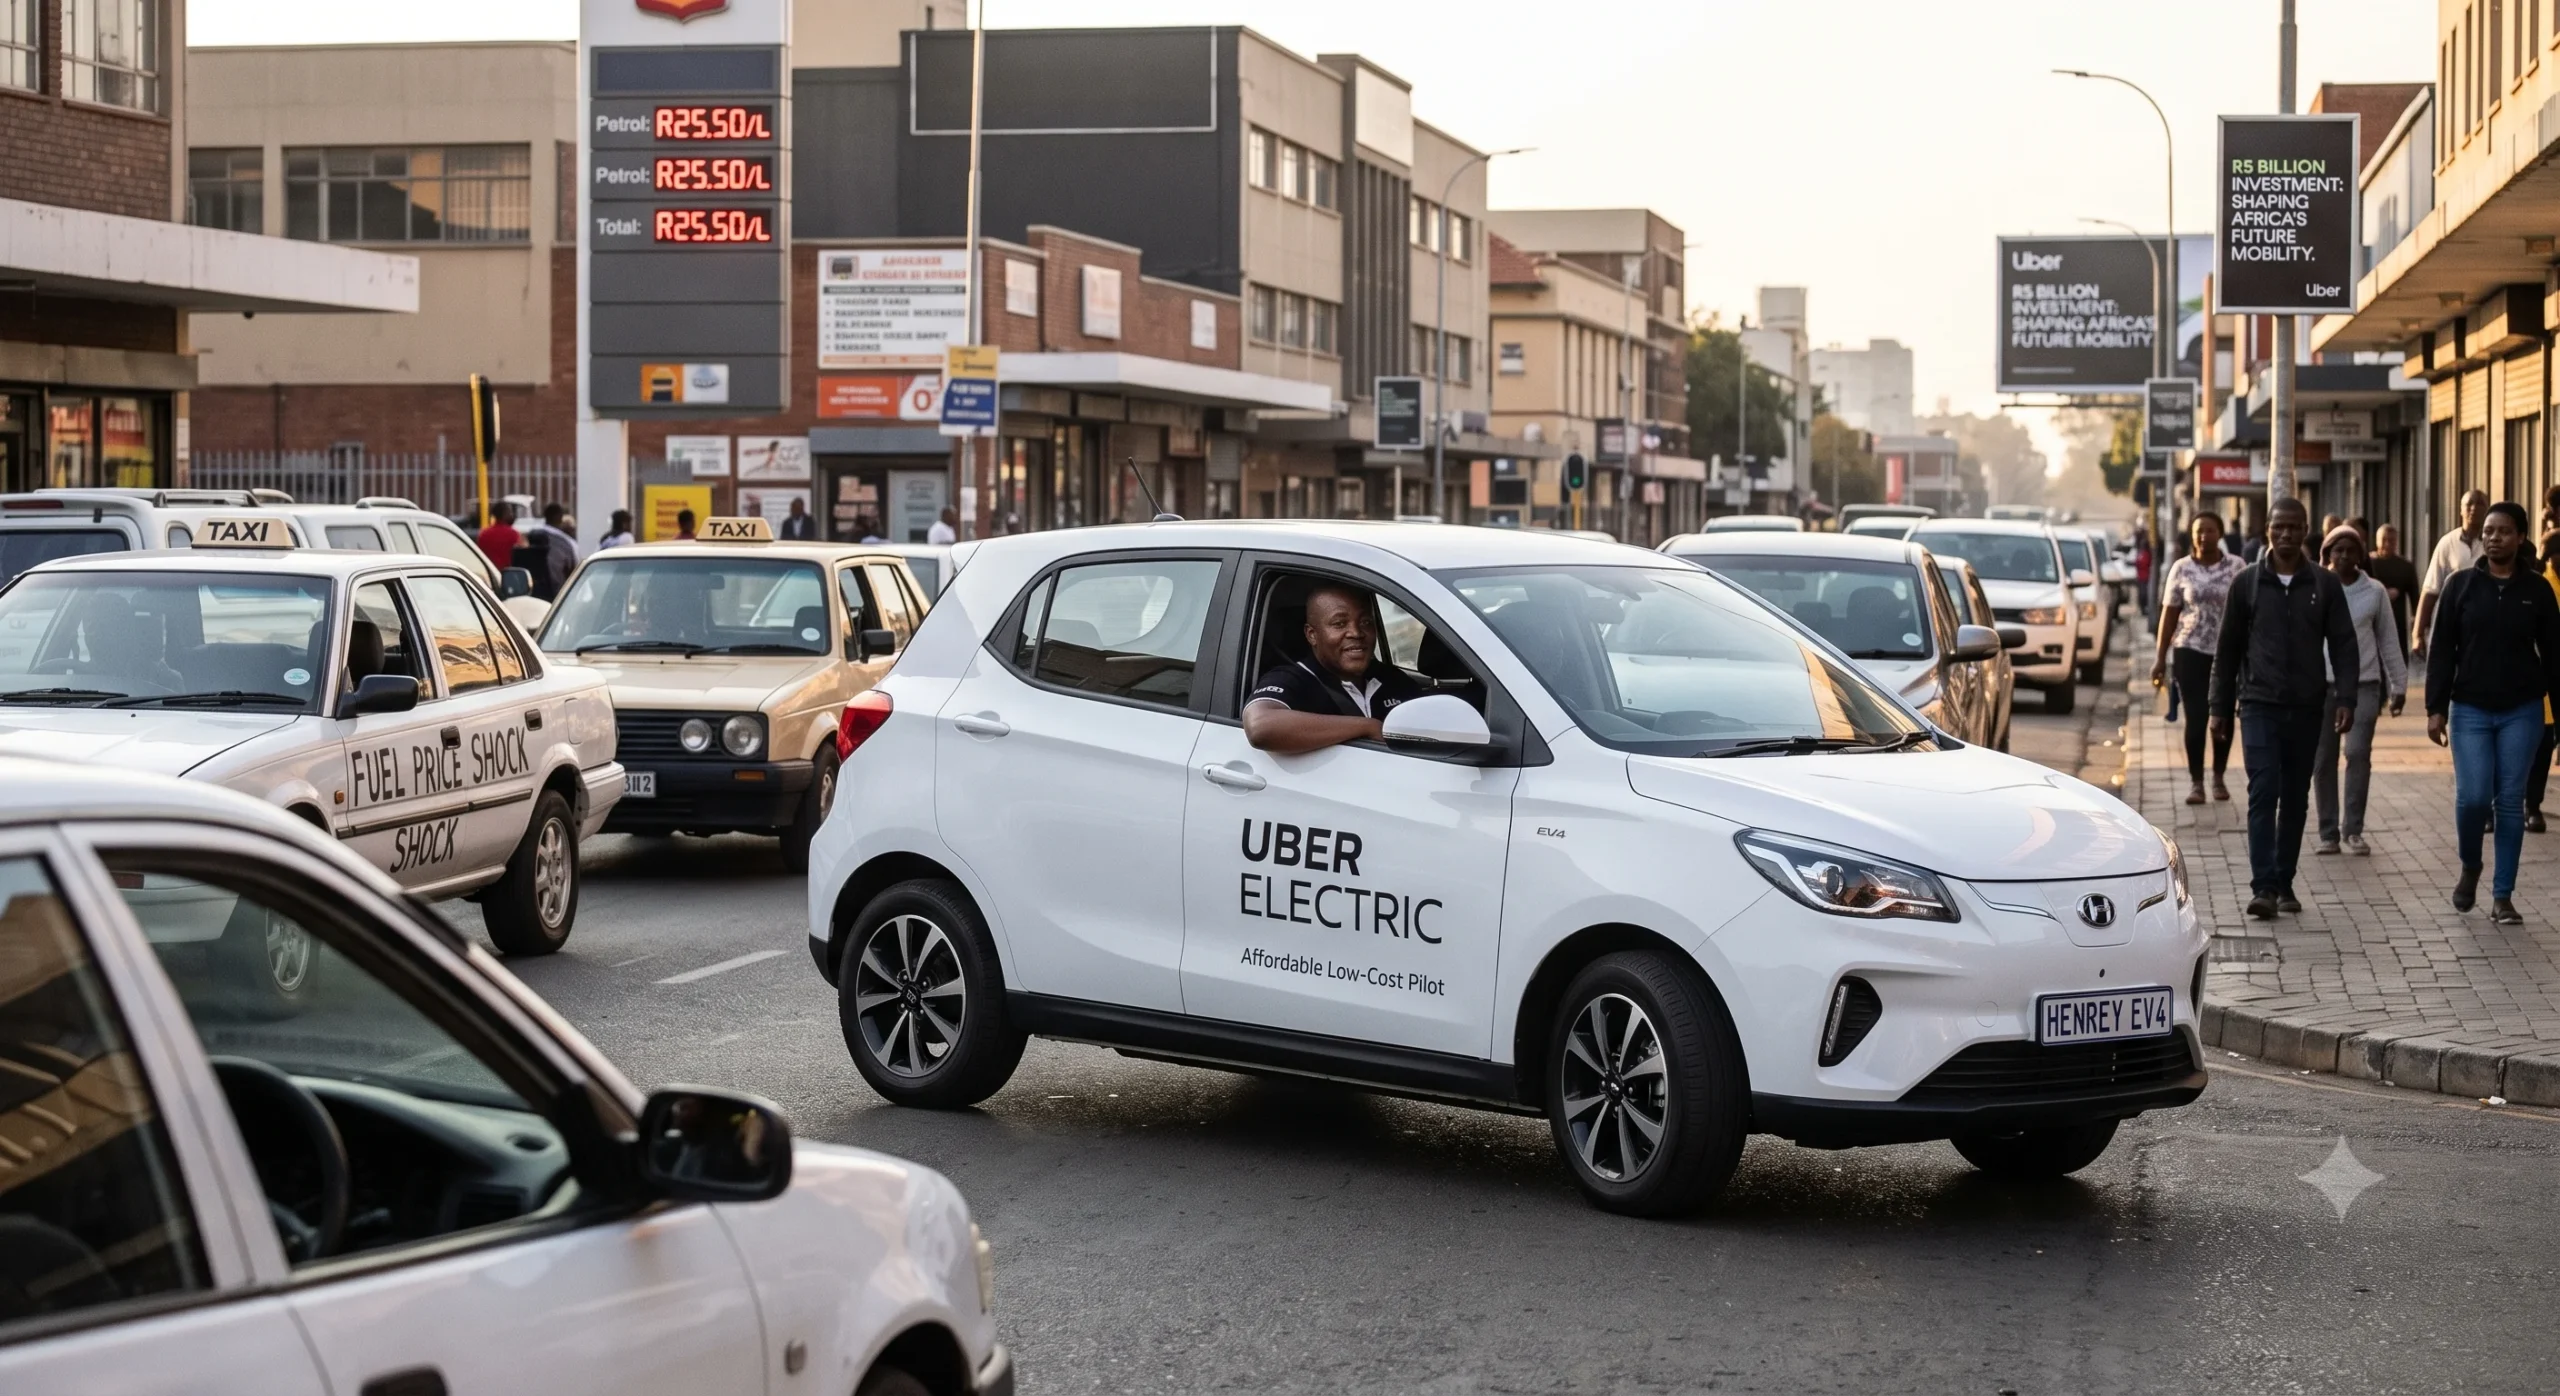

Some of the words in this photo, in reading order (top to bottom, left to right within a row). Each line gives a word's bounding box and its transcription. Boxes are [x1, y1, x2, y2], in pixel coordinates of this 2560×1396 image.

[596, 115, 651, 132] Petrol:
[656, 109, 771, 139] R25.50/L
[2232, 159, 2254, 174] R5
[2257, 159, 2326, 174] BILLION
[596, 167, 651, 184] Petrol:
[656, 160, 771, 190] R25.50/L
[2232, 177, 2344, 192] INVESTMENT:
[2231, 194, 2309, 209] SHAPING
[596, 218, 642, 235] Total:
[656, 211, 771, 241] R25.50/L
[2231, 211, 2308, 226] AFRICA'S
[2231, 229, 2296, 244] FUTURE
[2012, 251, 2063, 271] Uber
[2231, 246, 2316, 261] MOBILITY.
[2036, 284, 2100, 299] BILLION
[2306, 283, 2341, 297] Uber
[2012, 299, 2119, 316] INVESTMENT:
[2012, 316, 2085, 331] SHAPING
[2012, 332, 2074, 348] FUTURE
[207, 521, 269, 542] TAXI
[708, 522, 756, 537] TAXI
[352, 747, 405, 807] FUEL
[412, 745, 463, 796] PRICE
[471, 726, 529, 784] SHOCK
[1536, 827, 1567, 839] EV4
[390, 817, 459, 873] SHOCK
[1241, 818, 1363, 876] UBER
[1241, 872, 1443, 944] ELECTRIC
[1241, 947, 1323, 976] Affordable
[1327, 960, 1404, 989] Low-Cost
[1408, 973, 1445, 996] Pilot
[2047, 1000, 2123, 1037] HENREY
[2131, 996, 2166, 1030] EV4
